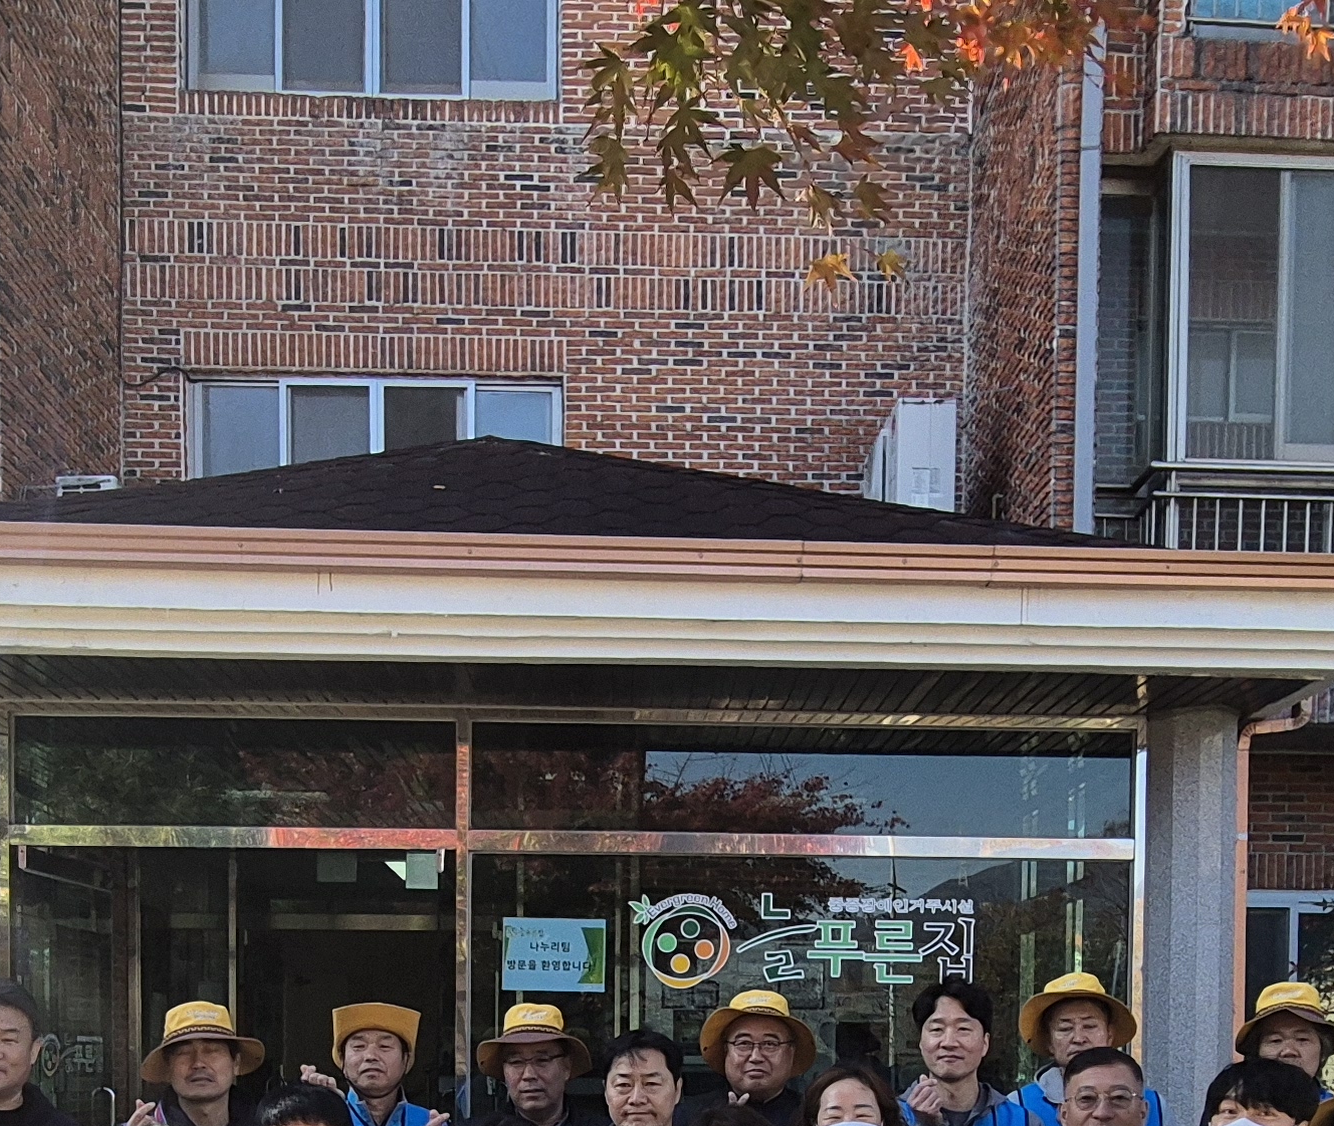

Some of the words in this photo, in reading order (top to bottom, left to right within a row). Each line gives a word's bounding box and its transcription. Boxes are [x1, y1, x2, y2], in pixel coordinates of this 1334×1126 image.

[647, 893, 711, 919] Evergreen
[710, 896, 738, 930] Home
[530, 941, 571, 953] 나누리팀
[507, 959, 537, 971] 방문을
